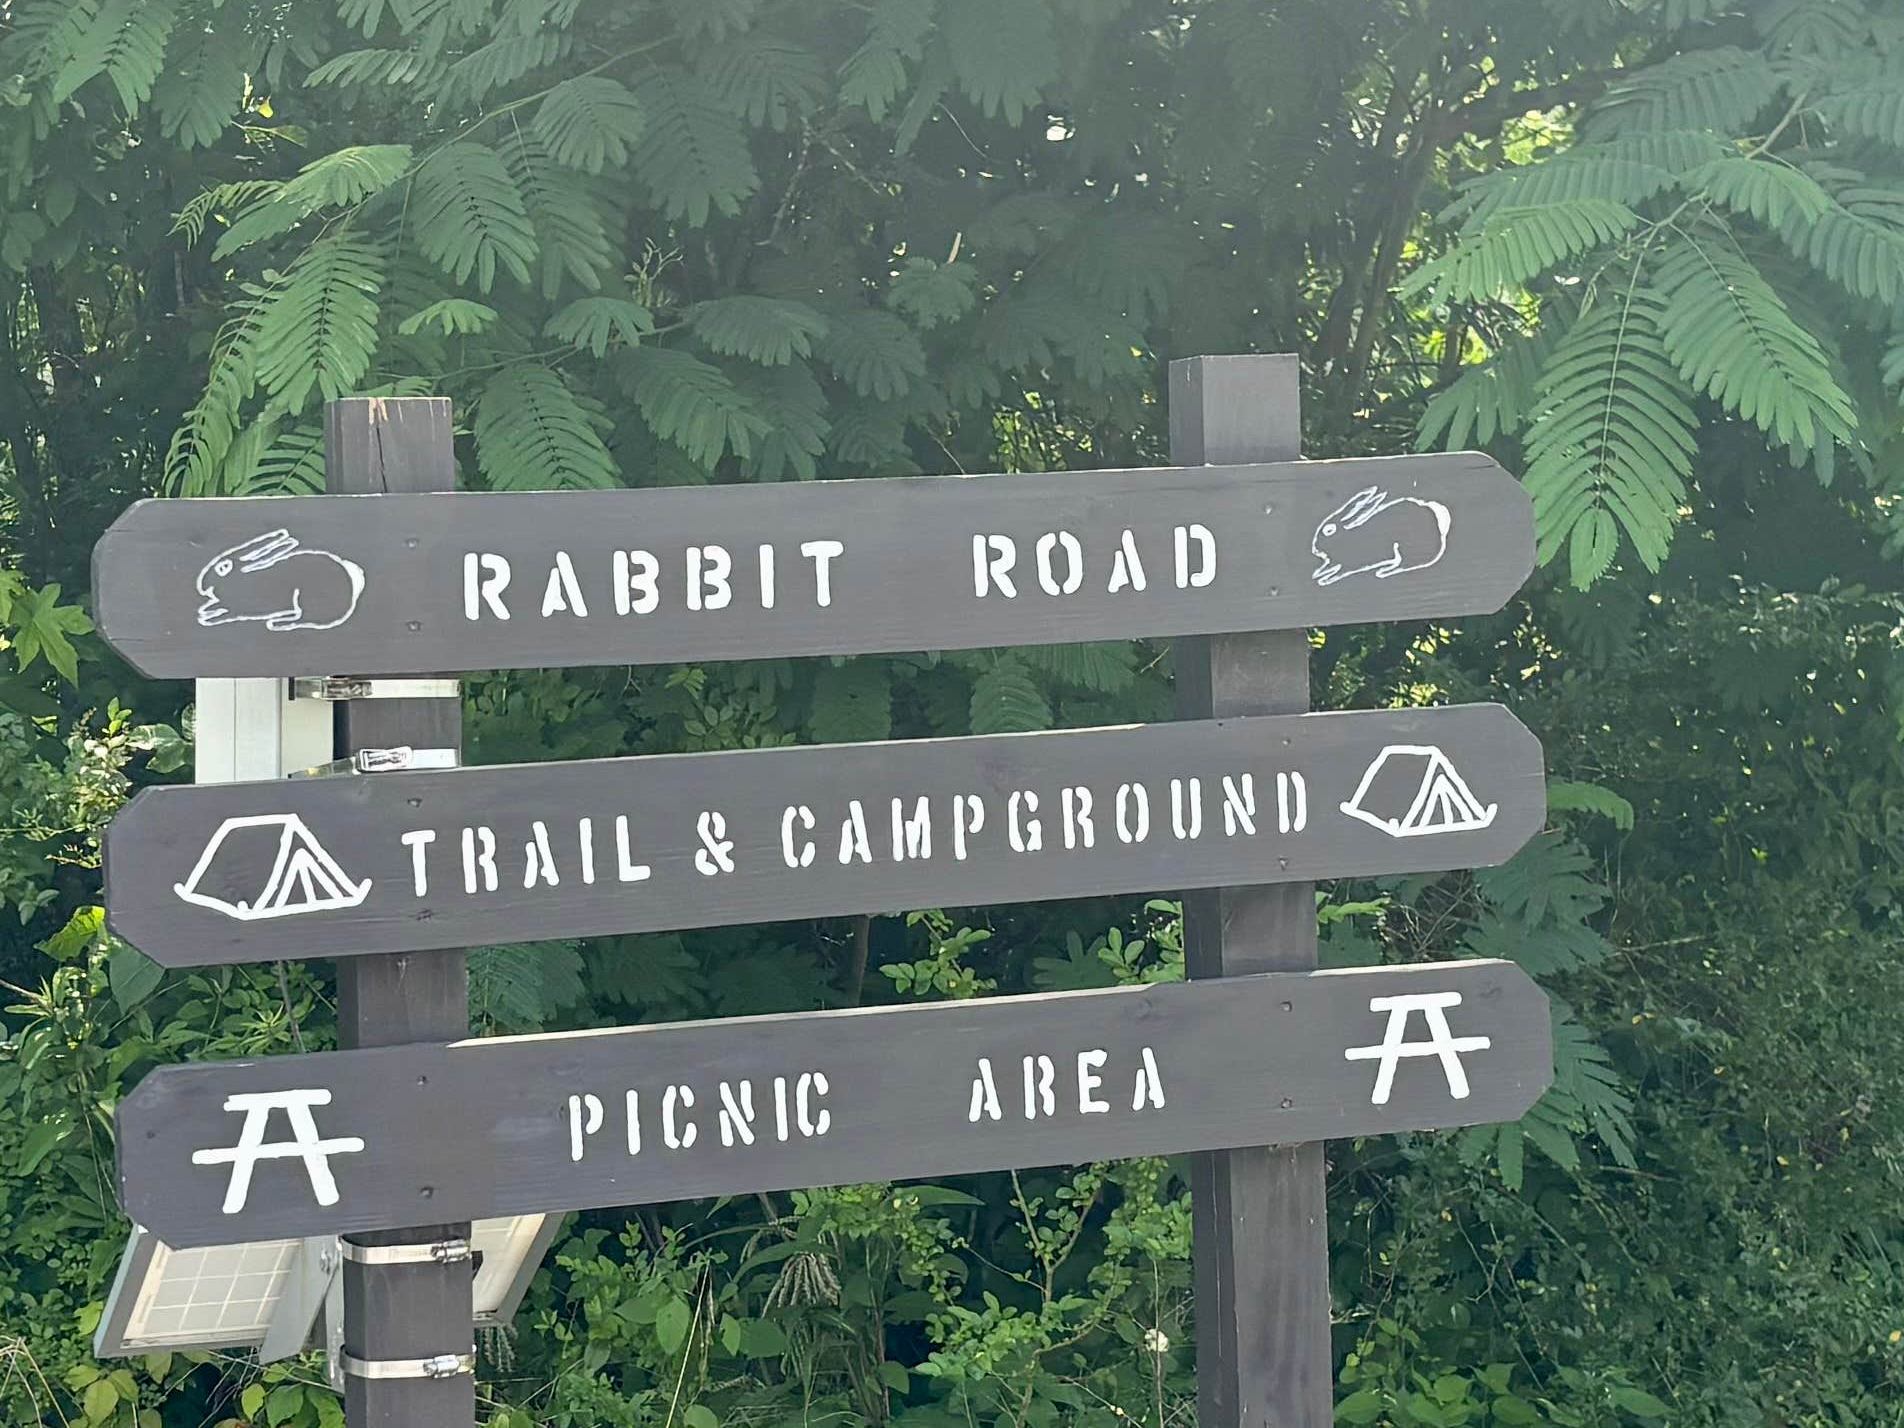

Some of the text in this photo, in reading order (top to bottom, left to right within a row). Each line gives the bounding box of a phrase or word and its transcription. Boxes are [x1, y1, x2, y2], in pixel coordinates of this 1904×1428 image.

[462, 522, 1218, 622] RABBIT ROAD
[400, 770, 1308, 898] TRAIL & CAMPGROUND
[567, 1046, 1167, 1163] PICNIC AREA
